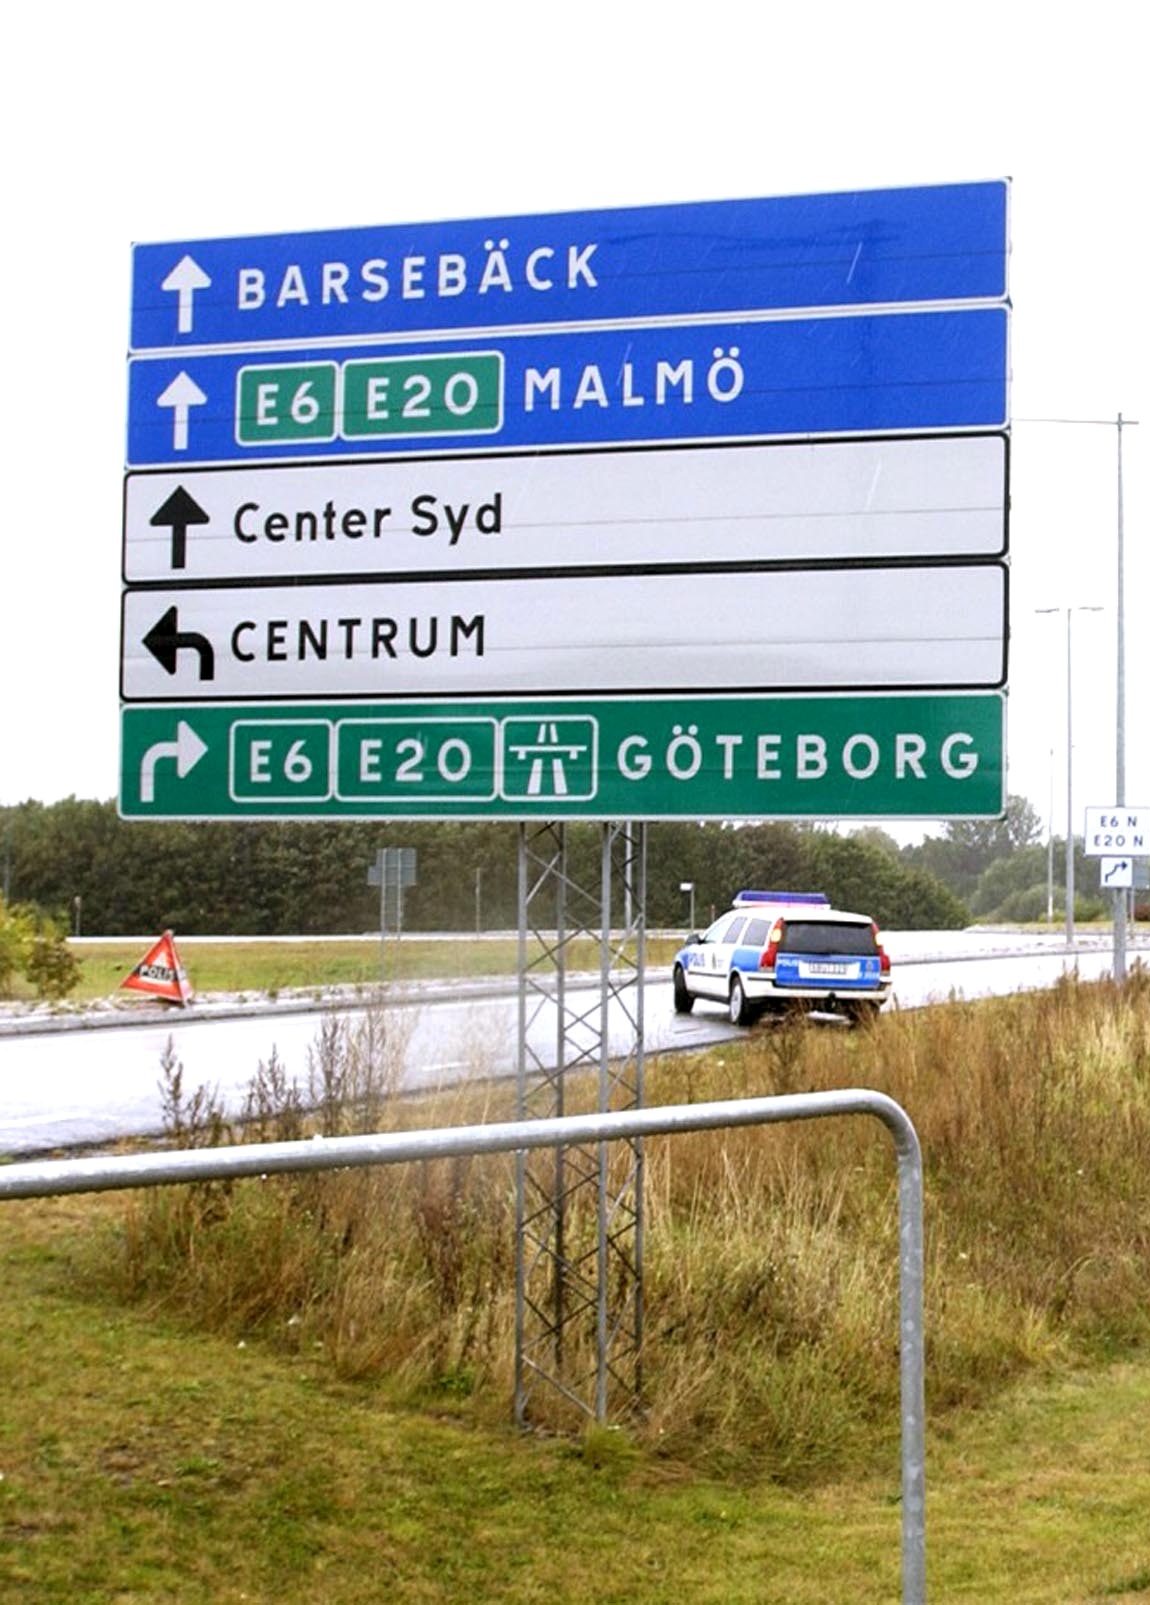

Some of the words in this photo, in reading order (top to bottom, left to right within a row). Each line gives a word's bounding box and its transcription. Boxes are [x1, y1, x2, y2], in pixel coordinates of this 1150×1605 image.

[237, 238, 599, 311] BARSEBÄCK
[256, 381, 319, 427] E6
[366, 372, 479, 421] E20
[524, 346, 745, 412] MALMÖ
[233, 501, 392, 543] Center
[410, 492, 502, 546] Syd
[231, 614, 486, 662] CENTRUM
[249, 739, 314, 784] E6
[359, 737, 473, 784] E20
[616, 724, 979, 781] GÖTEBORG
[1094, 835, 1125, 847] E20
[1133, 835, 1143, 847] N
[1100, 815, 1119, 827] E6
[1127, 816, 1137, 827] N
[140, 964, 175, 981] POLIS
